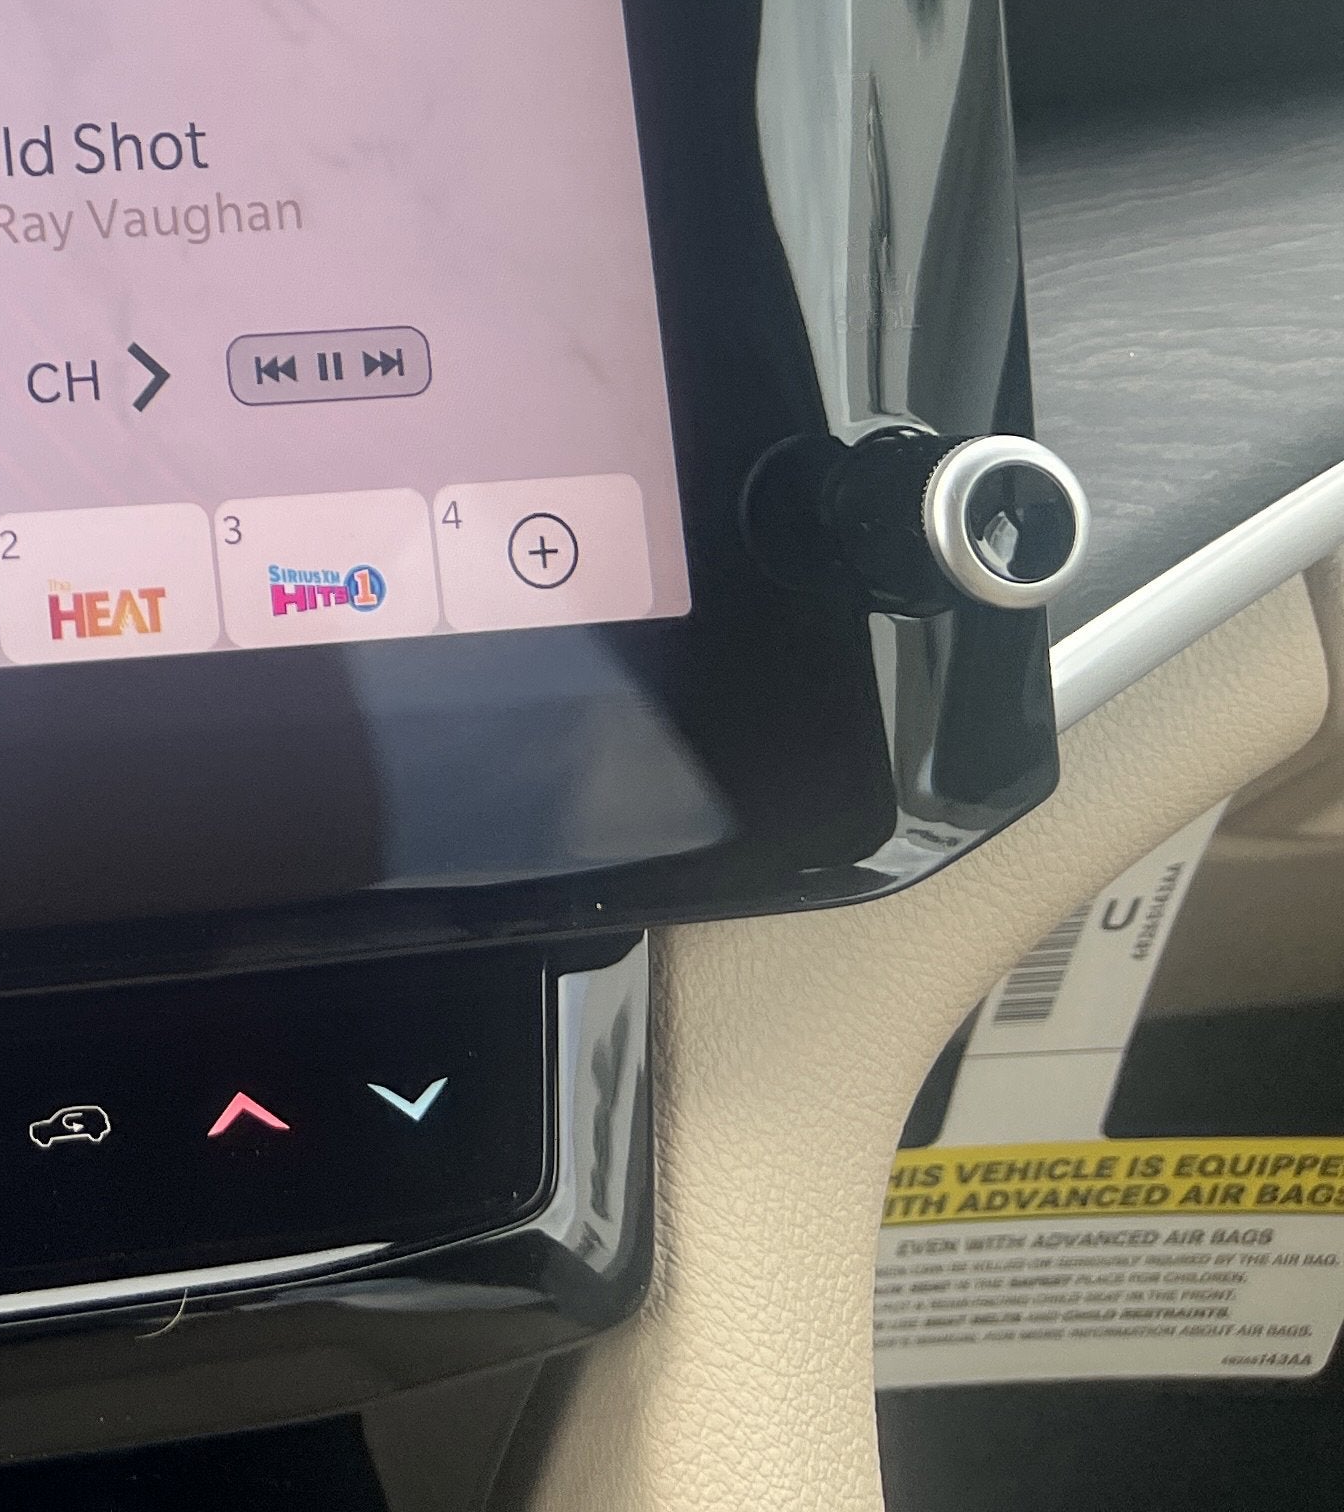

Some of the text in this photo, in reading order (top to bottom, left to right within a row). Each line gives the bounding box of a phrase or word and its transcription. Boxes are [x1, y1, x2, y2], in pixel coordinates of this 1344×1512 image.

[73, 121, 211, 176] Shot
[84, 191, 305, 245] Vaughan
[26, 360, 101, 404] CH
[223, 515, 242, 545] 3
[441, 500, 463, 529] 4
[0, 530, 21, 561] 2
[270, 568, 378, 616] HITS 1
[47, 587, 167, 640] HEAT
[888, 1153, 1344, 1189] HIS VEHICLE IS EQUIPPE
[884, 1192, 949, 1217] ITH
[957, 1183, 1172, 1213] ADVANCED
[1177, 1182, 1248, 1206] AIR
[1162, 1228, 1206, 1245] AIR
[1209, 1228, 1275, 1246] BAGS
